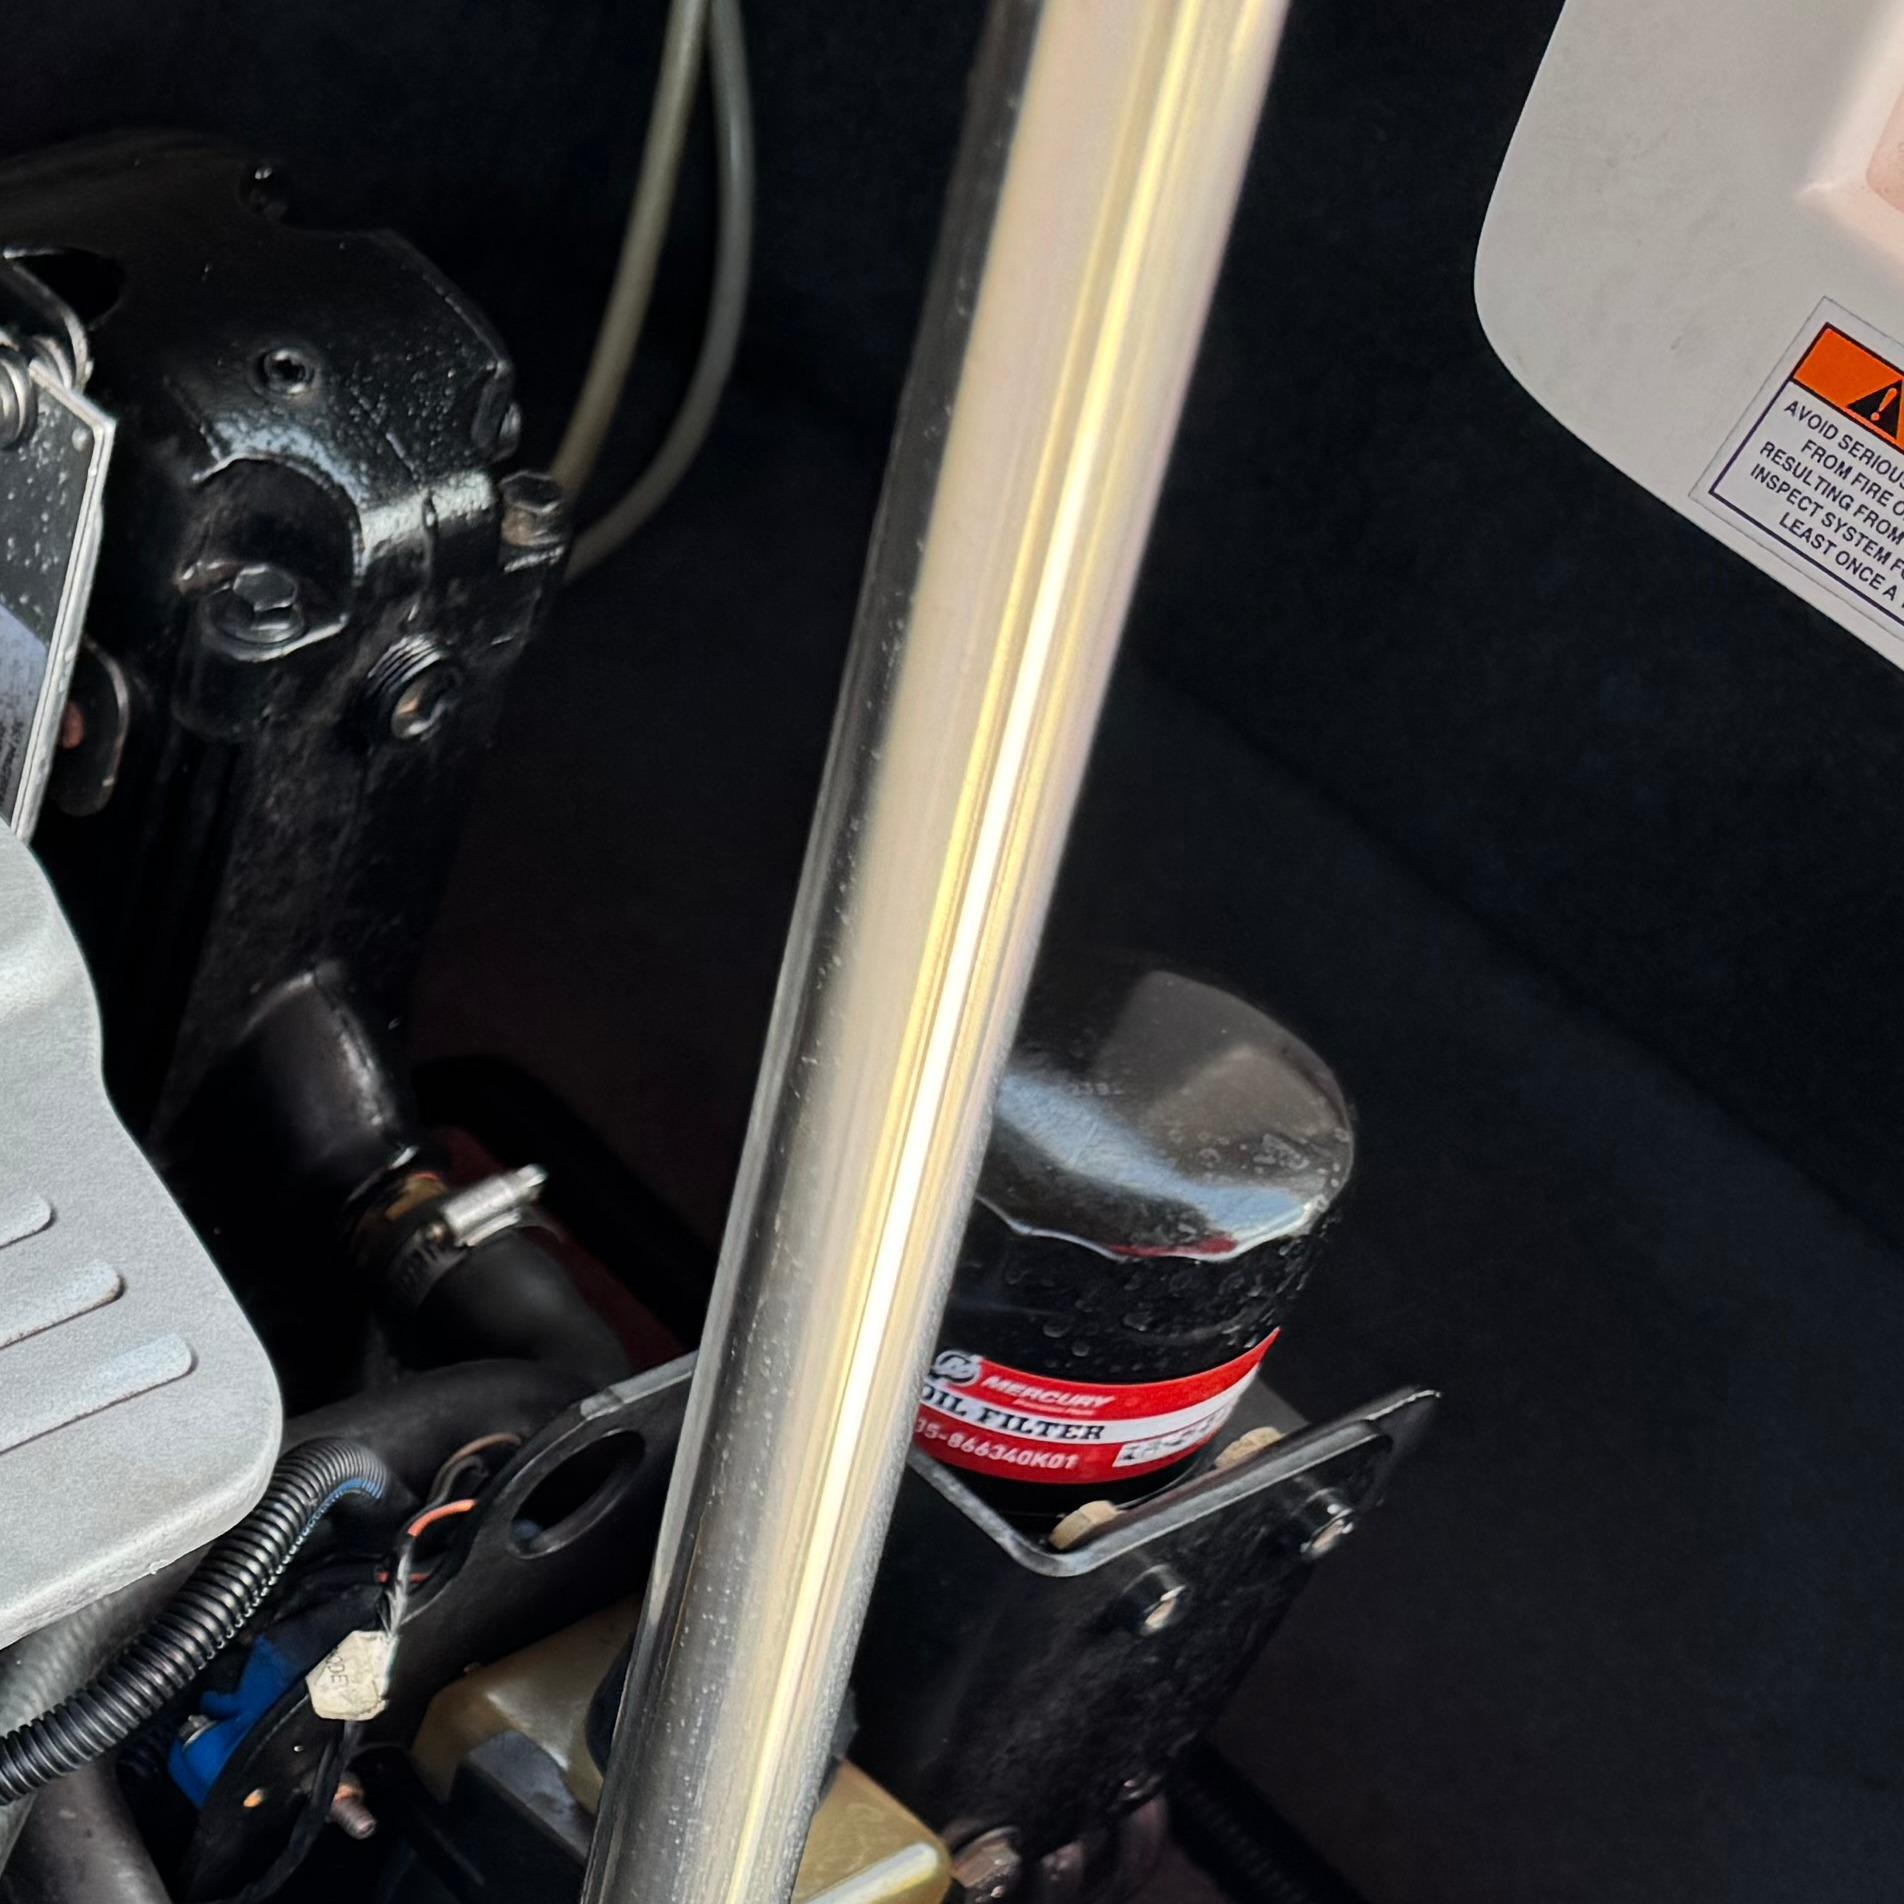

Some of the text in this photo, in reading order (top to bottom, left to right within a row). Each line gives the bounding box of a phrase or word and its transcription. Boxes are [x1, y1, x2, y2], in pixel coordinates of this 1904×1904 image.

[1784, 400, 1839, 441] AVOID
[1750, 464, 1824, 518] INSPECT
[1822, 512, 1891, 567] SYSTEM
[1760, 441, 1904, 547] RESULTING FROM
[1801, 439, 1904, 522] FROM FIRE O
[1779, 511, 1899, 602] LEAST ONCE A
[979, 1409, 1104, 1441] FILTER
[982, 1375, 1115, 1407] MERCURY
